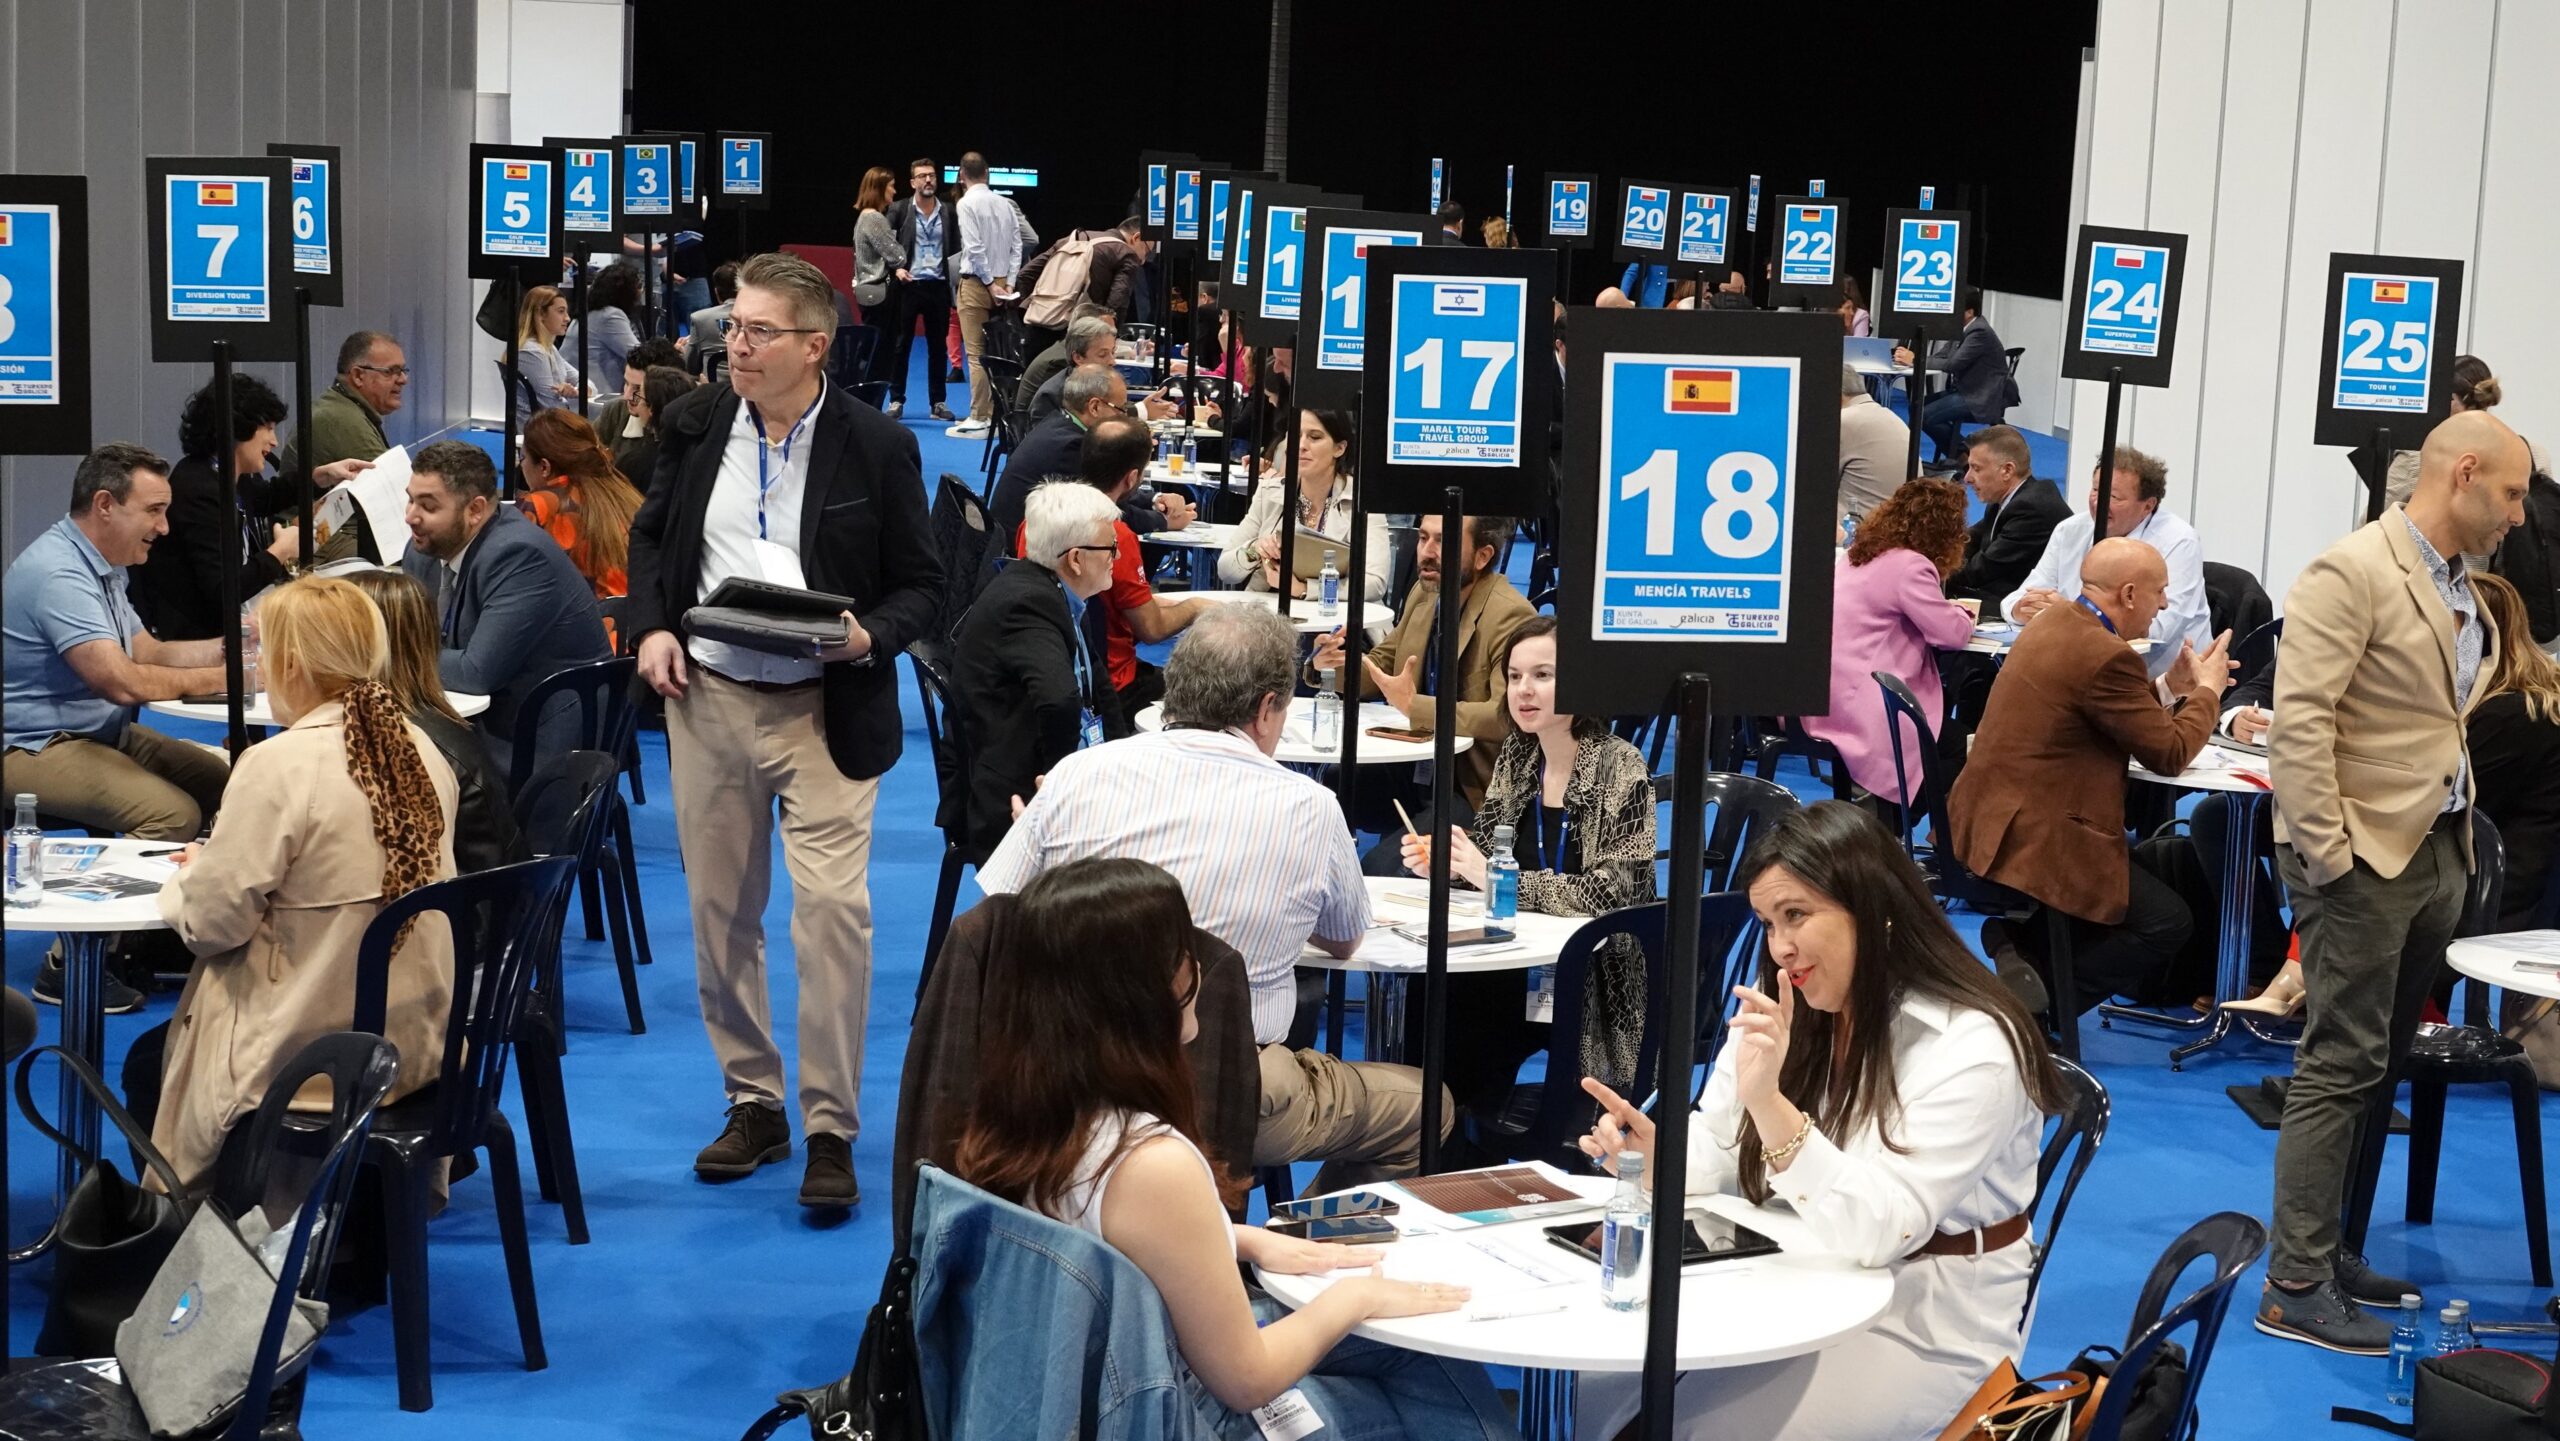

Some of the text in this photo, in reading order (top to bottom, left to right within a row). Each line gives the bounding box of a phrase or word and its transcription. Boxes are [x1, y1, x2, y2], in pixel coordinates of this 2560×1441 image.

[637, 168, 657, 194] 3
[736, 157, 747, 178] 1
[570, 176, 596, 207] 4
[293, 196, 314, 240] 6
[502, 192, 530, 228] 5
[1555, 198, 1586, 220] 19
[1627, 206, 1664, 231] 20
[1683, 212, 1720, 239] 21
[197, 224, 239, 278] 7
[1786, 230, 1832, 261] 22
[1900, 250, 1952, 286] 23
[2090, 279, 2158, 324] 24
[2343, 318, 2426, 373] 25
[1404, 338, 1515, 410] 17
[1419, 434, 1489, 443] TRAVEL GROUP
[1422, 425, 1488, 434] MARAL TOURS
[1443, 447, 1470, 455] galicia
[1621, 449, 1779, 559] 18
[1634, 584, 1751, 598] MENCÍA TRAVELS
[1676, 613, 1715, 626] galicia
